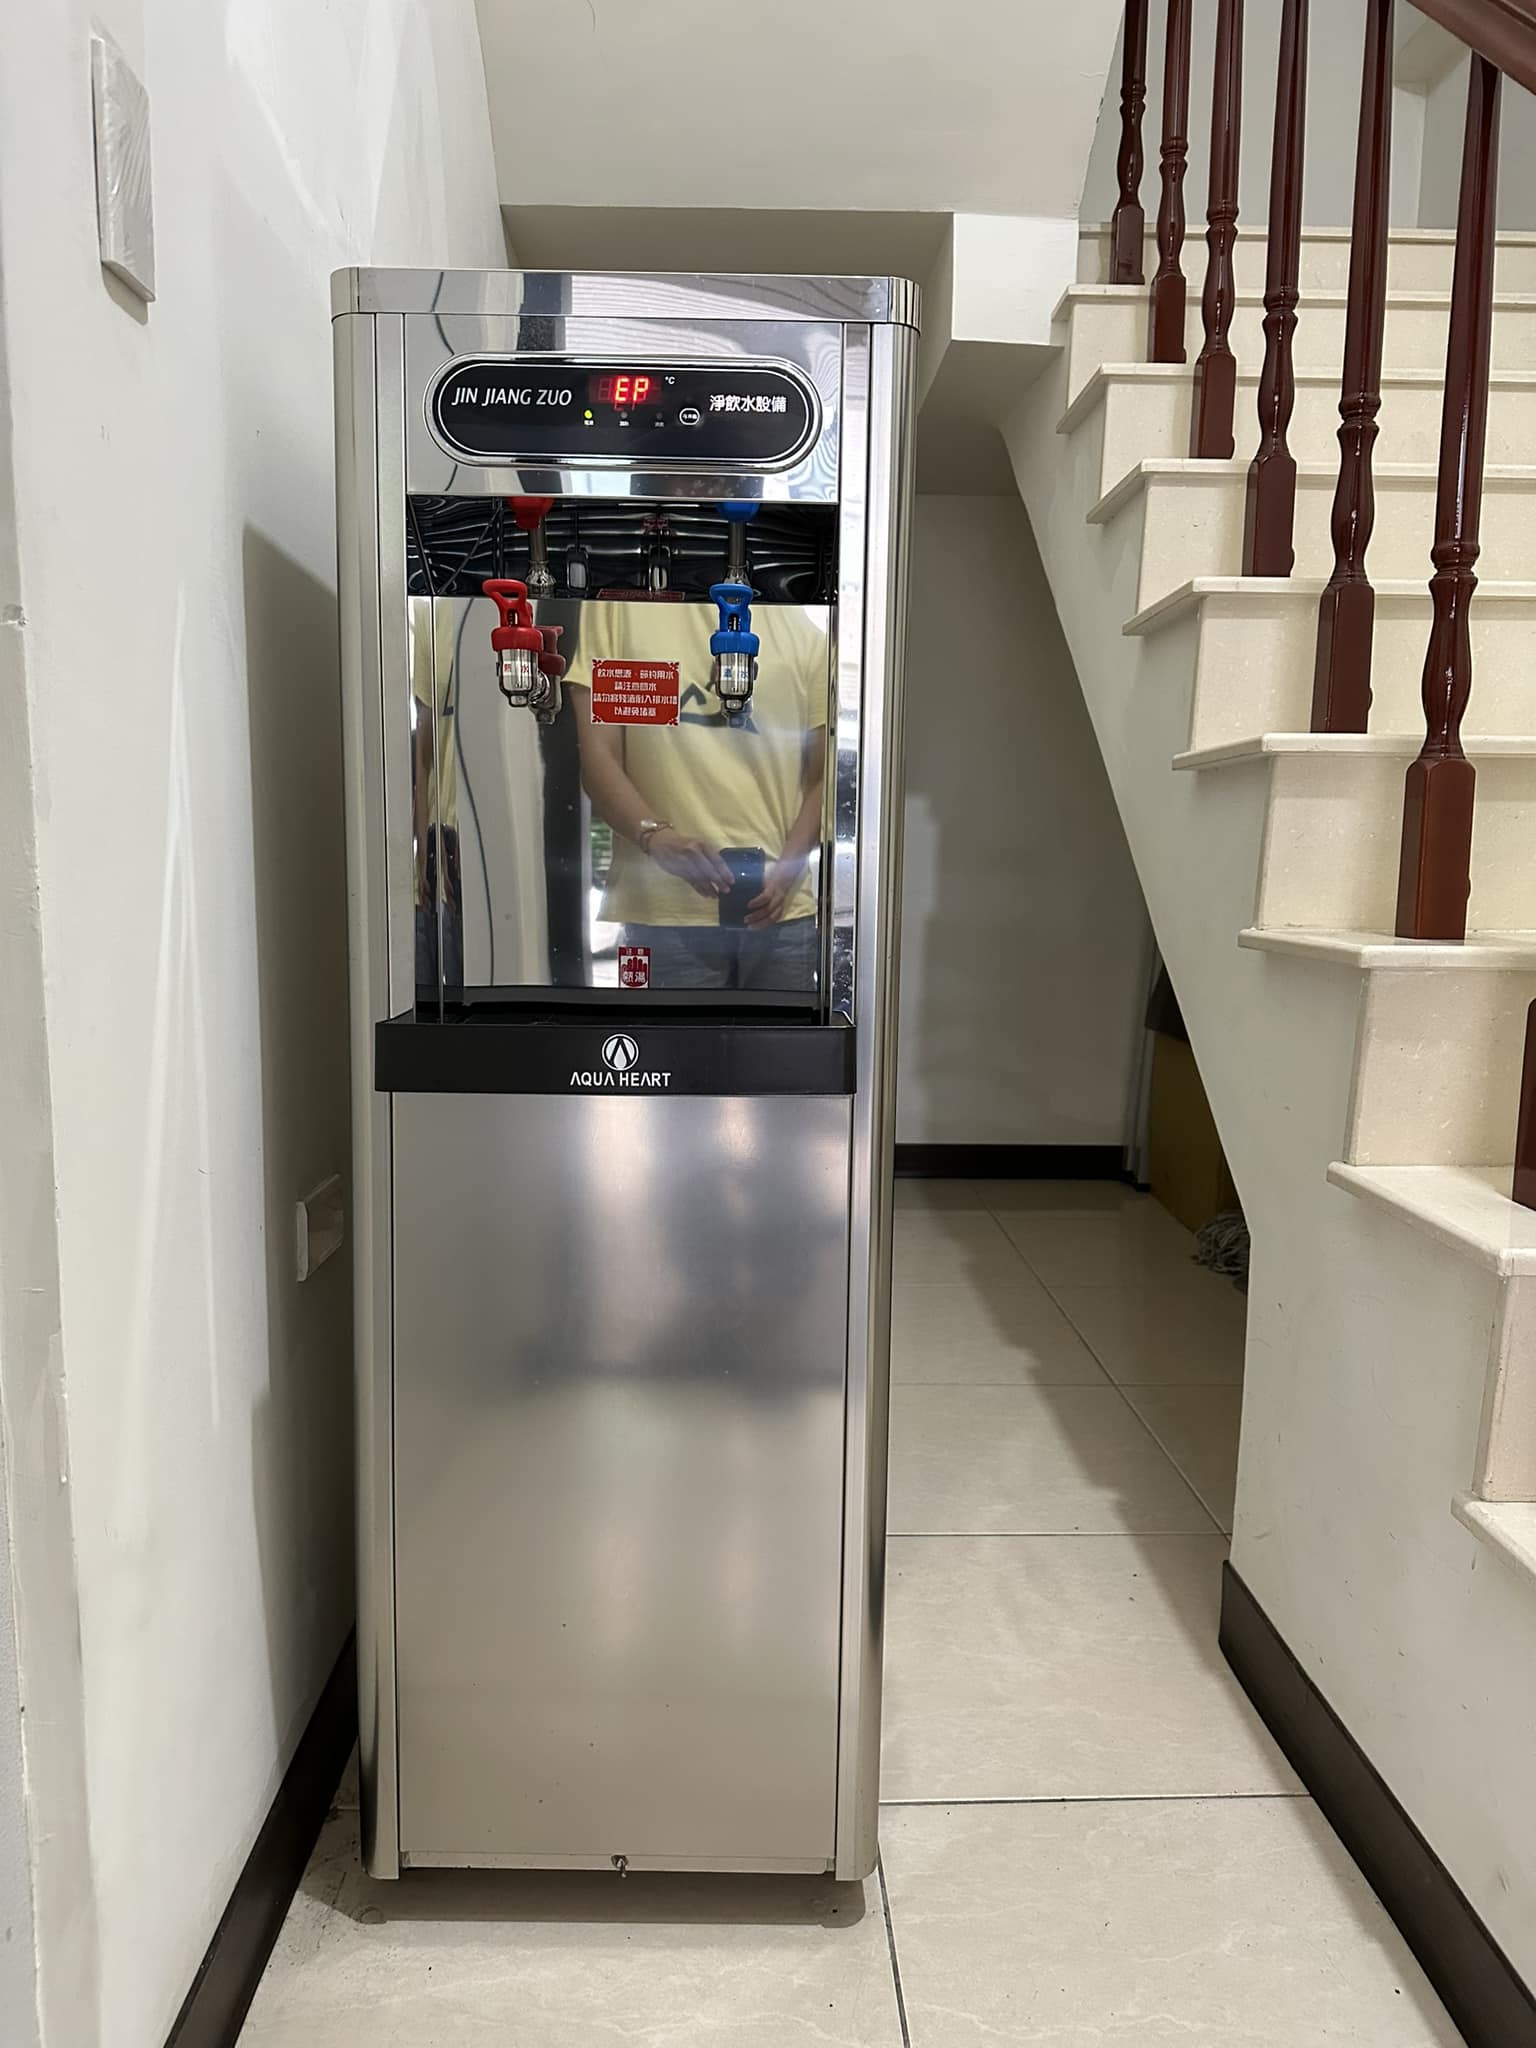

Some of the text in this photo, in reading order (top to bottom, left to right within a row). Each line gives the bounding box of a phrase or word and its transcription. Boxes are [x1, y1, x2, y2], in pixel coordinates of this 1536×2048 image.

[451, 387, 572, 407] JIN JIANG ZUO
[614, 377, 649, 402] EP
[709, 394, 787, 413] 淨飲水設備
[570, 1071, 672, 1087] AQUA HEART
